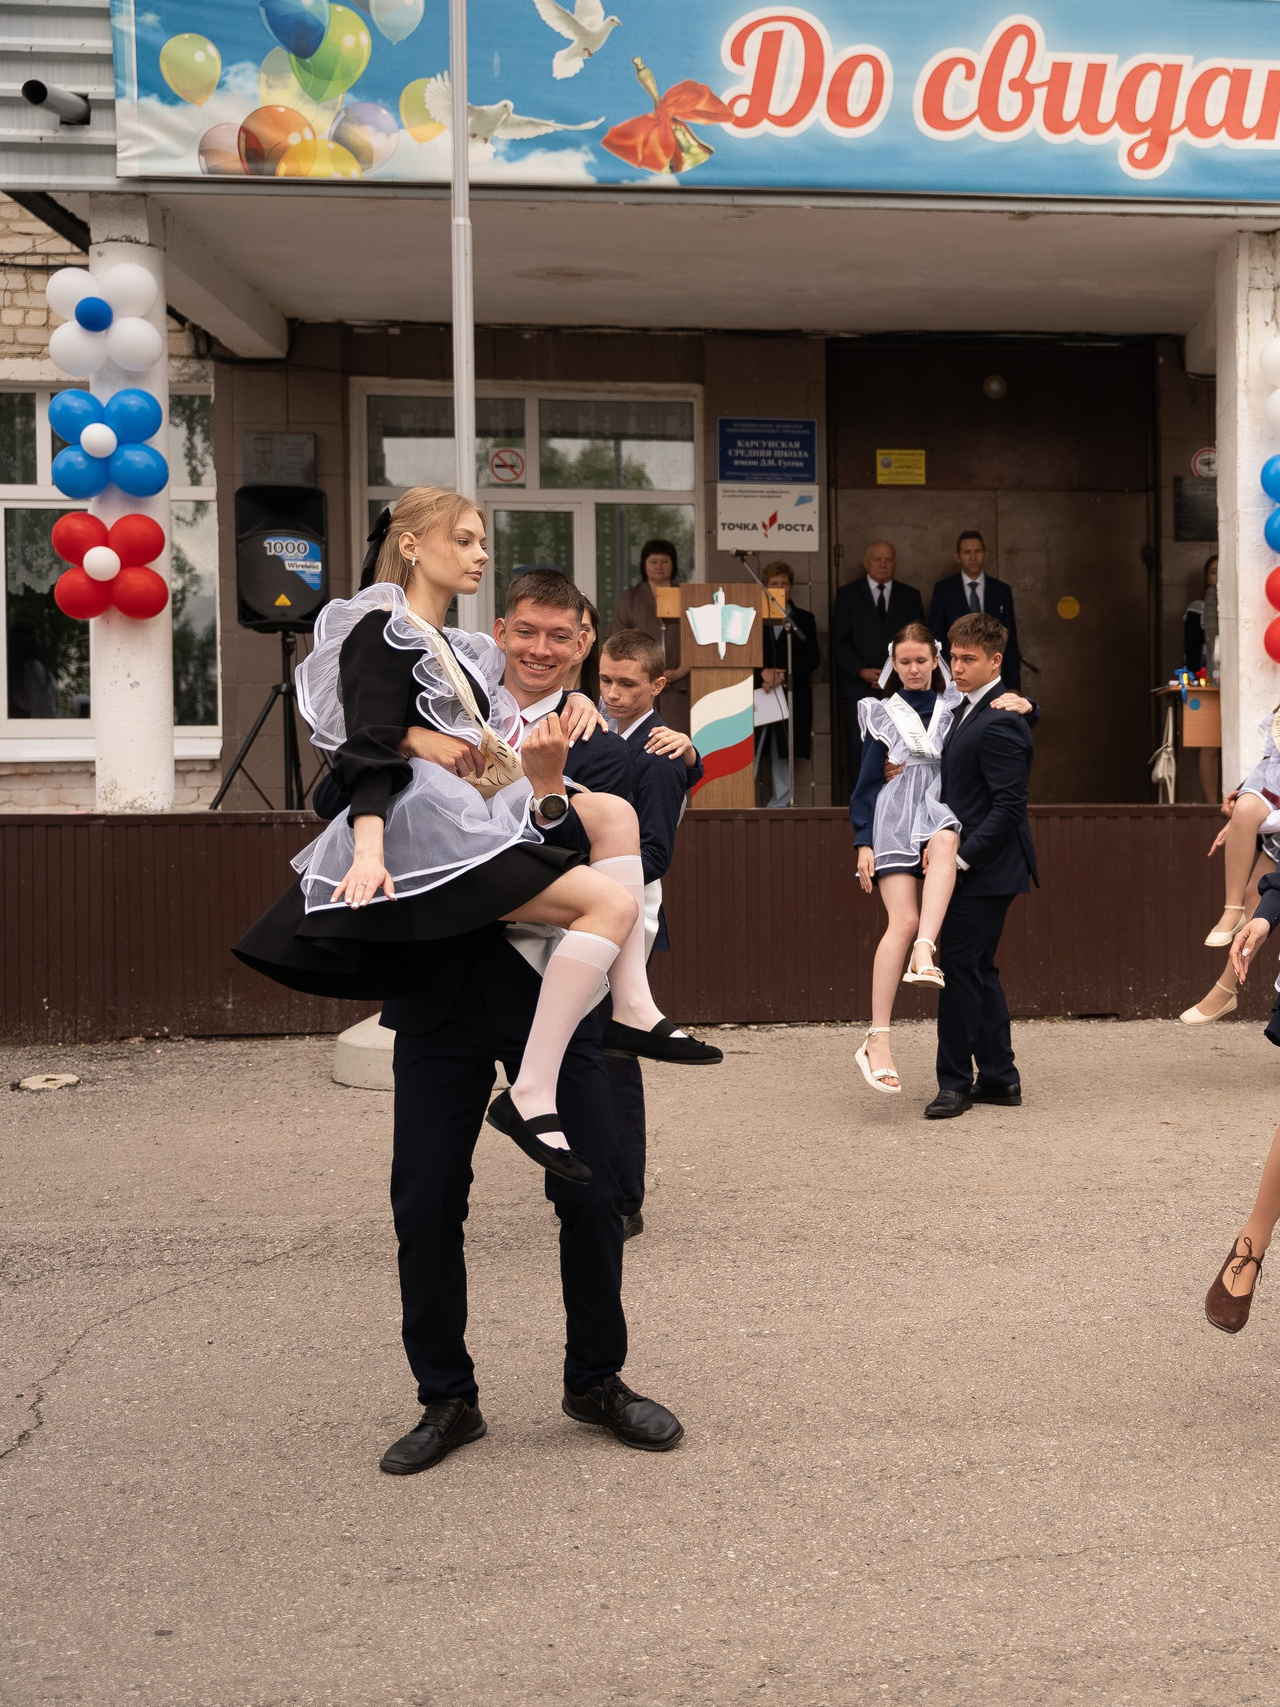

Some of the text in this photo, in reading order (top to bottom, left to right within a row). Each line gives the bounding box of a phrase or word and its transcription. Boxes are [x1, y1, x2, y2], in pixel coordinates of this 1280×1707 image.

[728, 13, 887, 130] До
[736, 439, 801, 449] КАРСУНСКАЯ
[727, 448, 809, 459] СРЕДНЯЯ ШКОЛА
[720, 522, 815, 532] ТОЧКА РОСТА
[263, 540, 309, 555] 1000
[287, 561, 320, 570] Wireless
